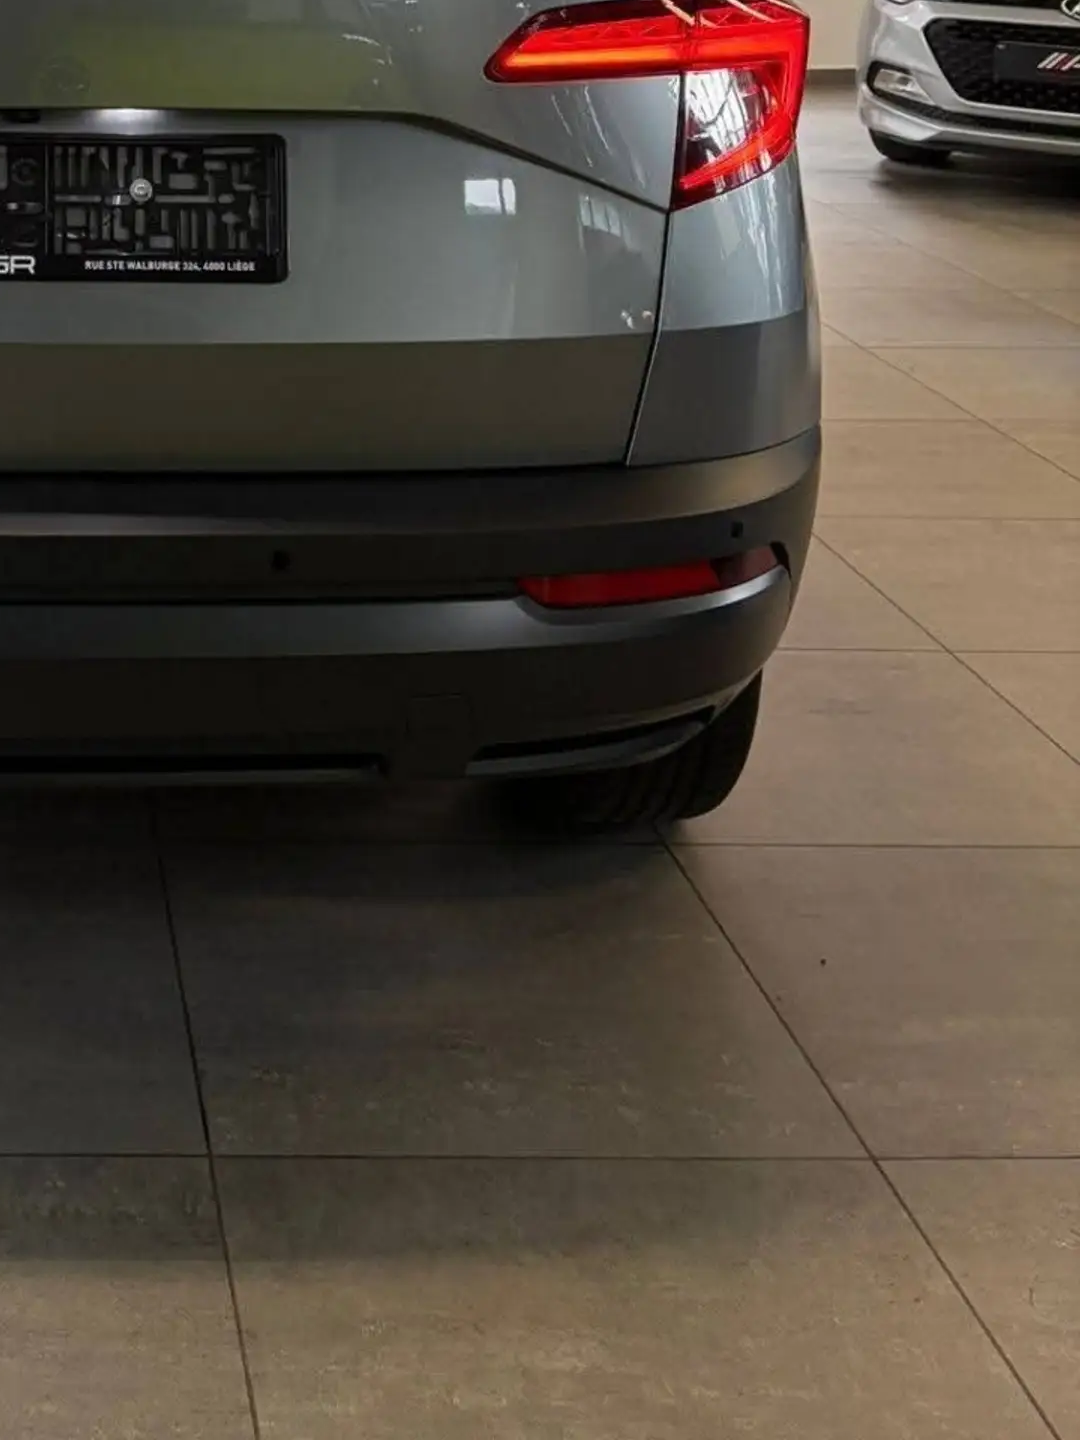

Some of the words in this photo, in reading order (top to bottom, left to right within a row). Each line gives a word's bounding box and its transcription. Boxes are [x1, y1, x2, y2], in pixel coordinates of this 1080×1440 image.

[84, 260, 105, 270] RUE
[106, 260, 125, 270] STE
[127, 260, 181, 271] WALBURGE
